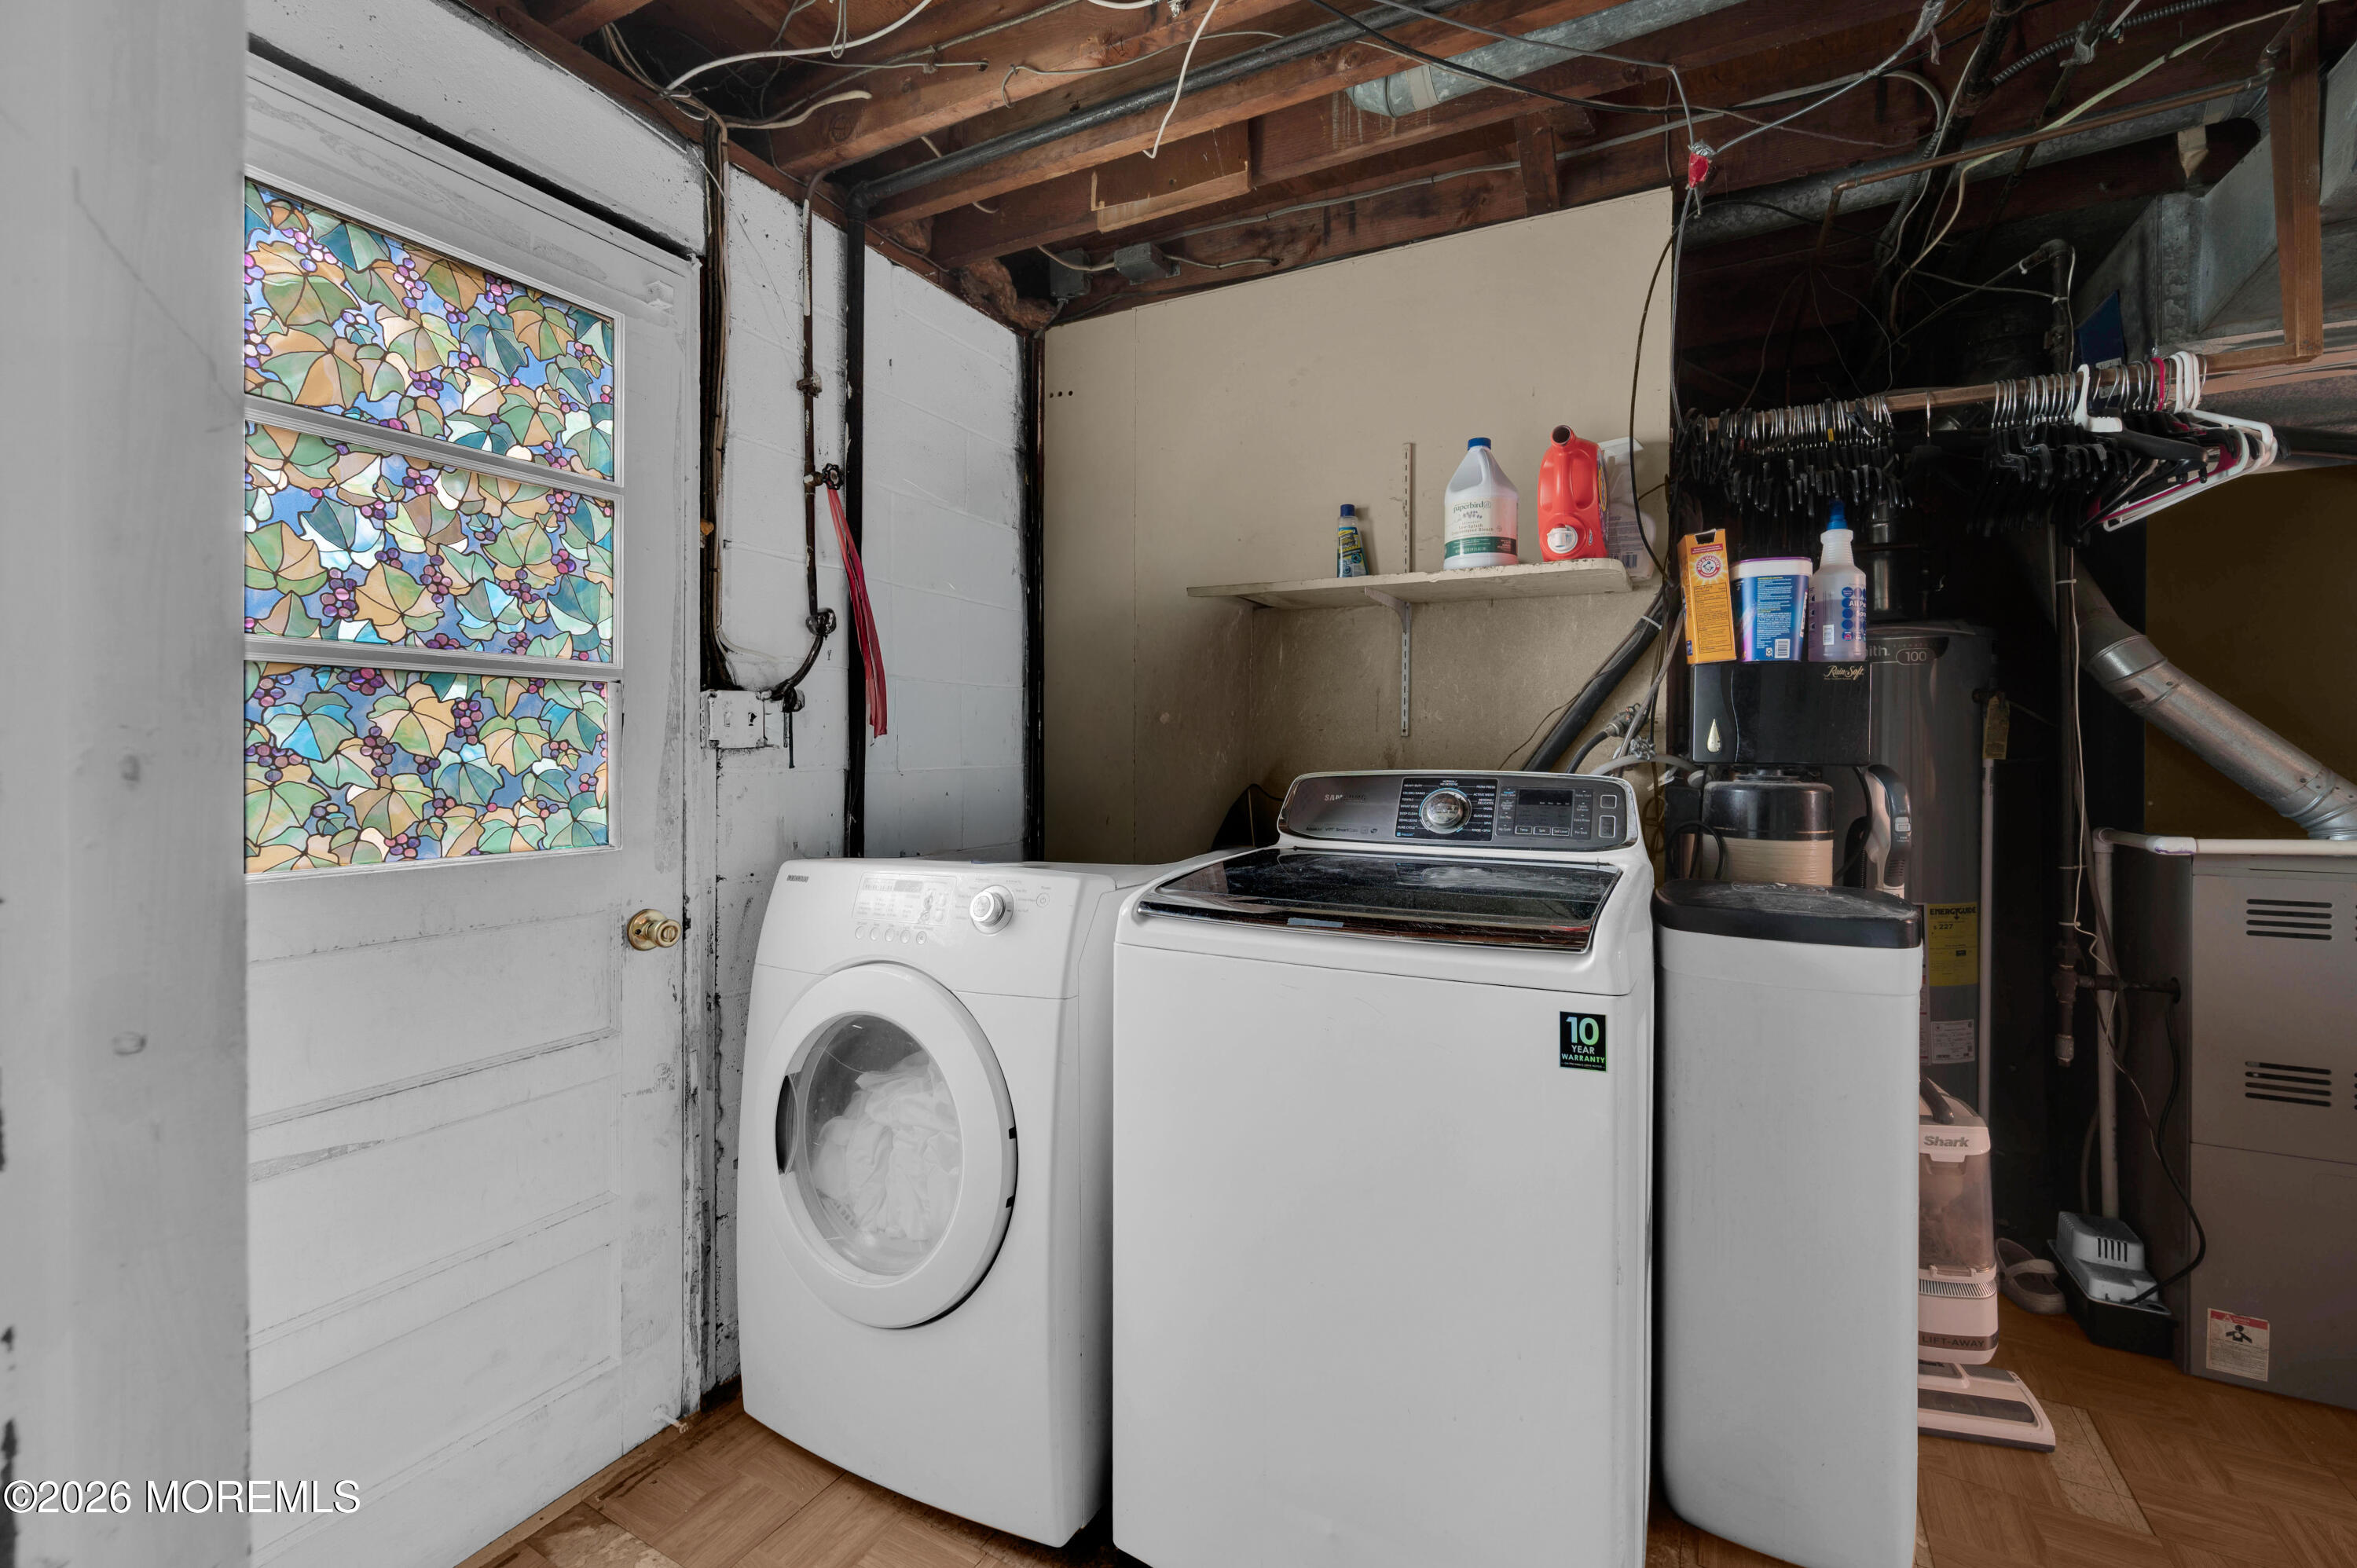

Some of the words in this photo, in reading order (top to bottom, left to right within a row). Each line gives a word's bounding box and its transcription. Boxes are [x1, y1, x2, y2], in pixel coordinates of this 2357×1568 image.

[1453, 500, 1484, 513] paperbird
[1905, 651, 1927, 662] 100
[1566, 1017, 1599, 1046] 10
[1571, 1045, 1595, 1055] YEAR
[1561, 1053, 1605, 1064] WARRANTY
[1923, 1135, 1970, 1147] Shark
[1922, 1335, 1985, 1347] LIFT-AWAY
